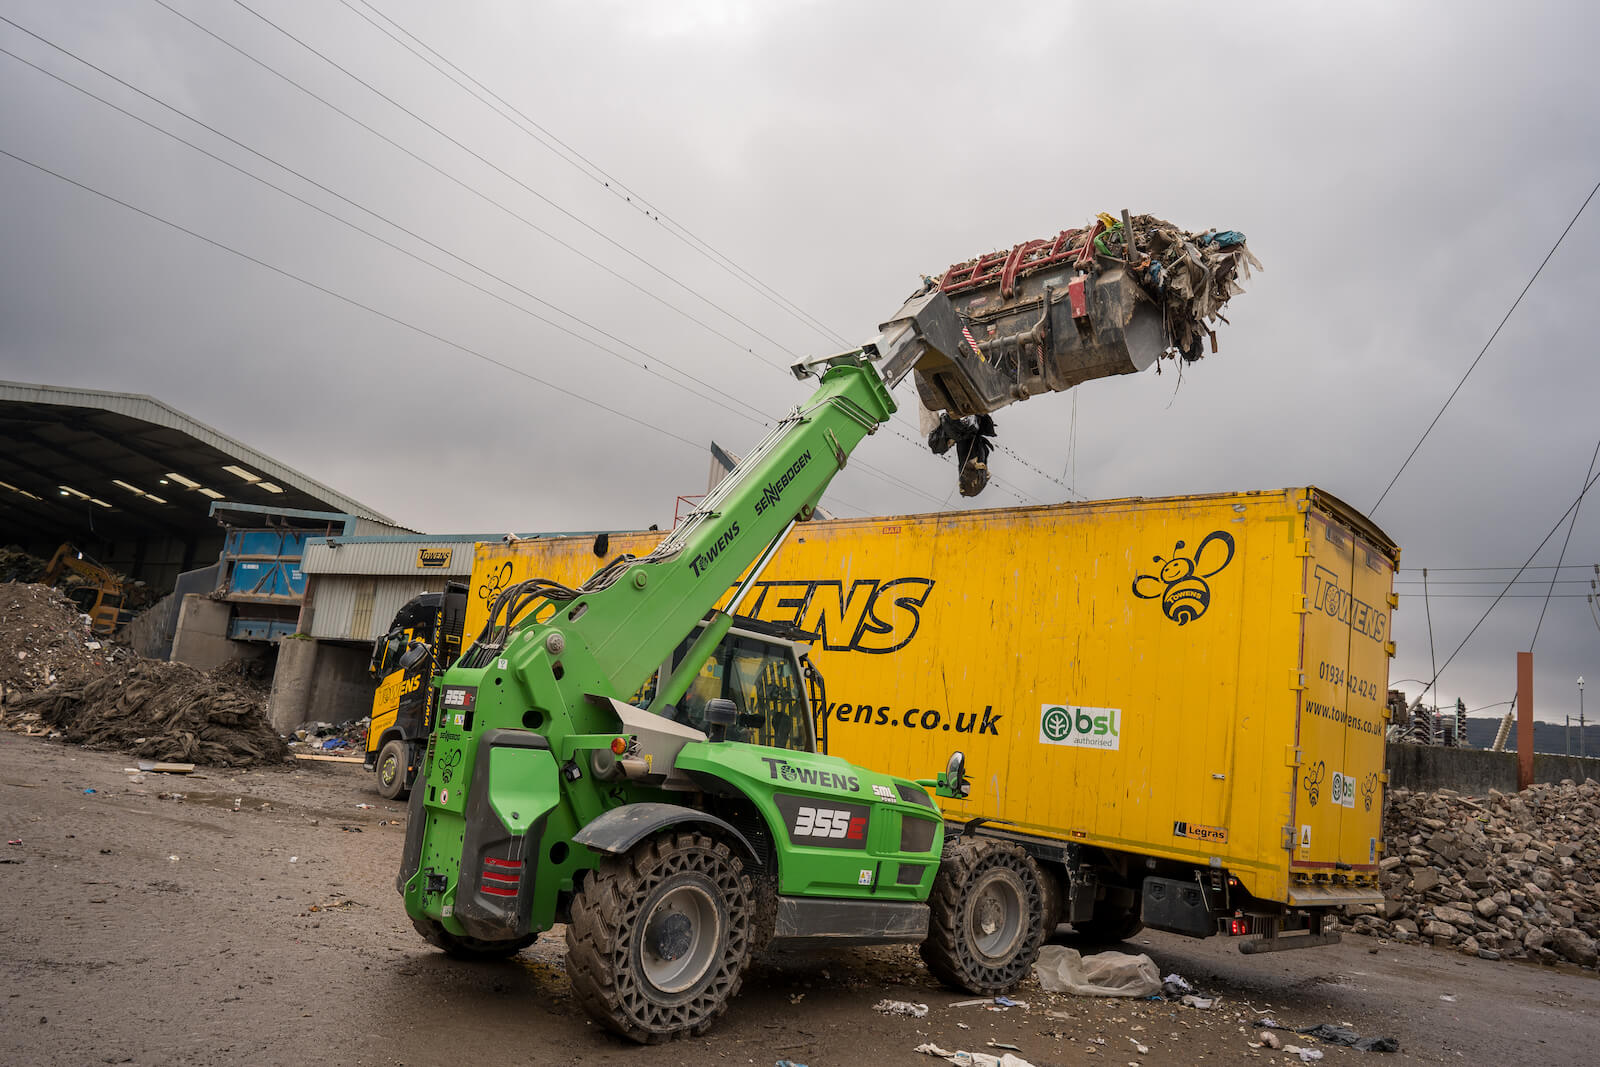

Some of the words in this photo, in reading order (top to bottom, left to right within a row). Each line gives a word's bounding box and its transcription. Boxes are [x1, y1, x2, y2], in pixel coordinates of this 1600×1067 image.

[754, 449, 812, 516] SENNEBOGEN
[419, 549, 450, 560] TOWENS
[688, 521, 740, 578] TOWENS
[1166, 591, 1202, 604] TOWENS
[1314, 564, 1387, 643] TOWENS
[1319, 661, 1345, 687] 01934
[815, 702, 1004, 736] wens.co.uk
[1075, 708, 1119, 737] bsl
[1305, 699, 1383, 737] www.towens.co.uk
[1073, 737, 1113, 747] authorised
[761, 757, 860, 792] TOWENS
[793, 806, 866, 840] 355E
[1189, 825, 1225, 838] Legras
